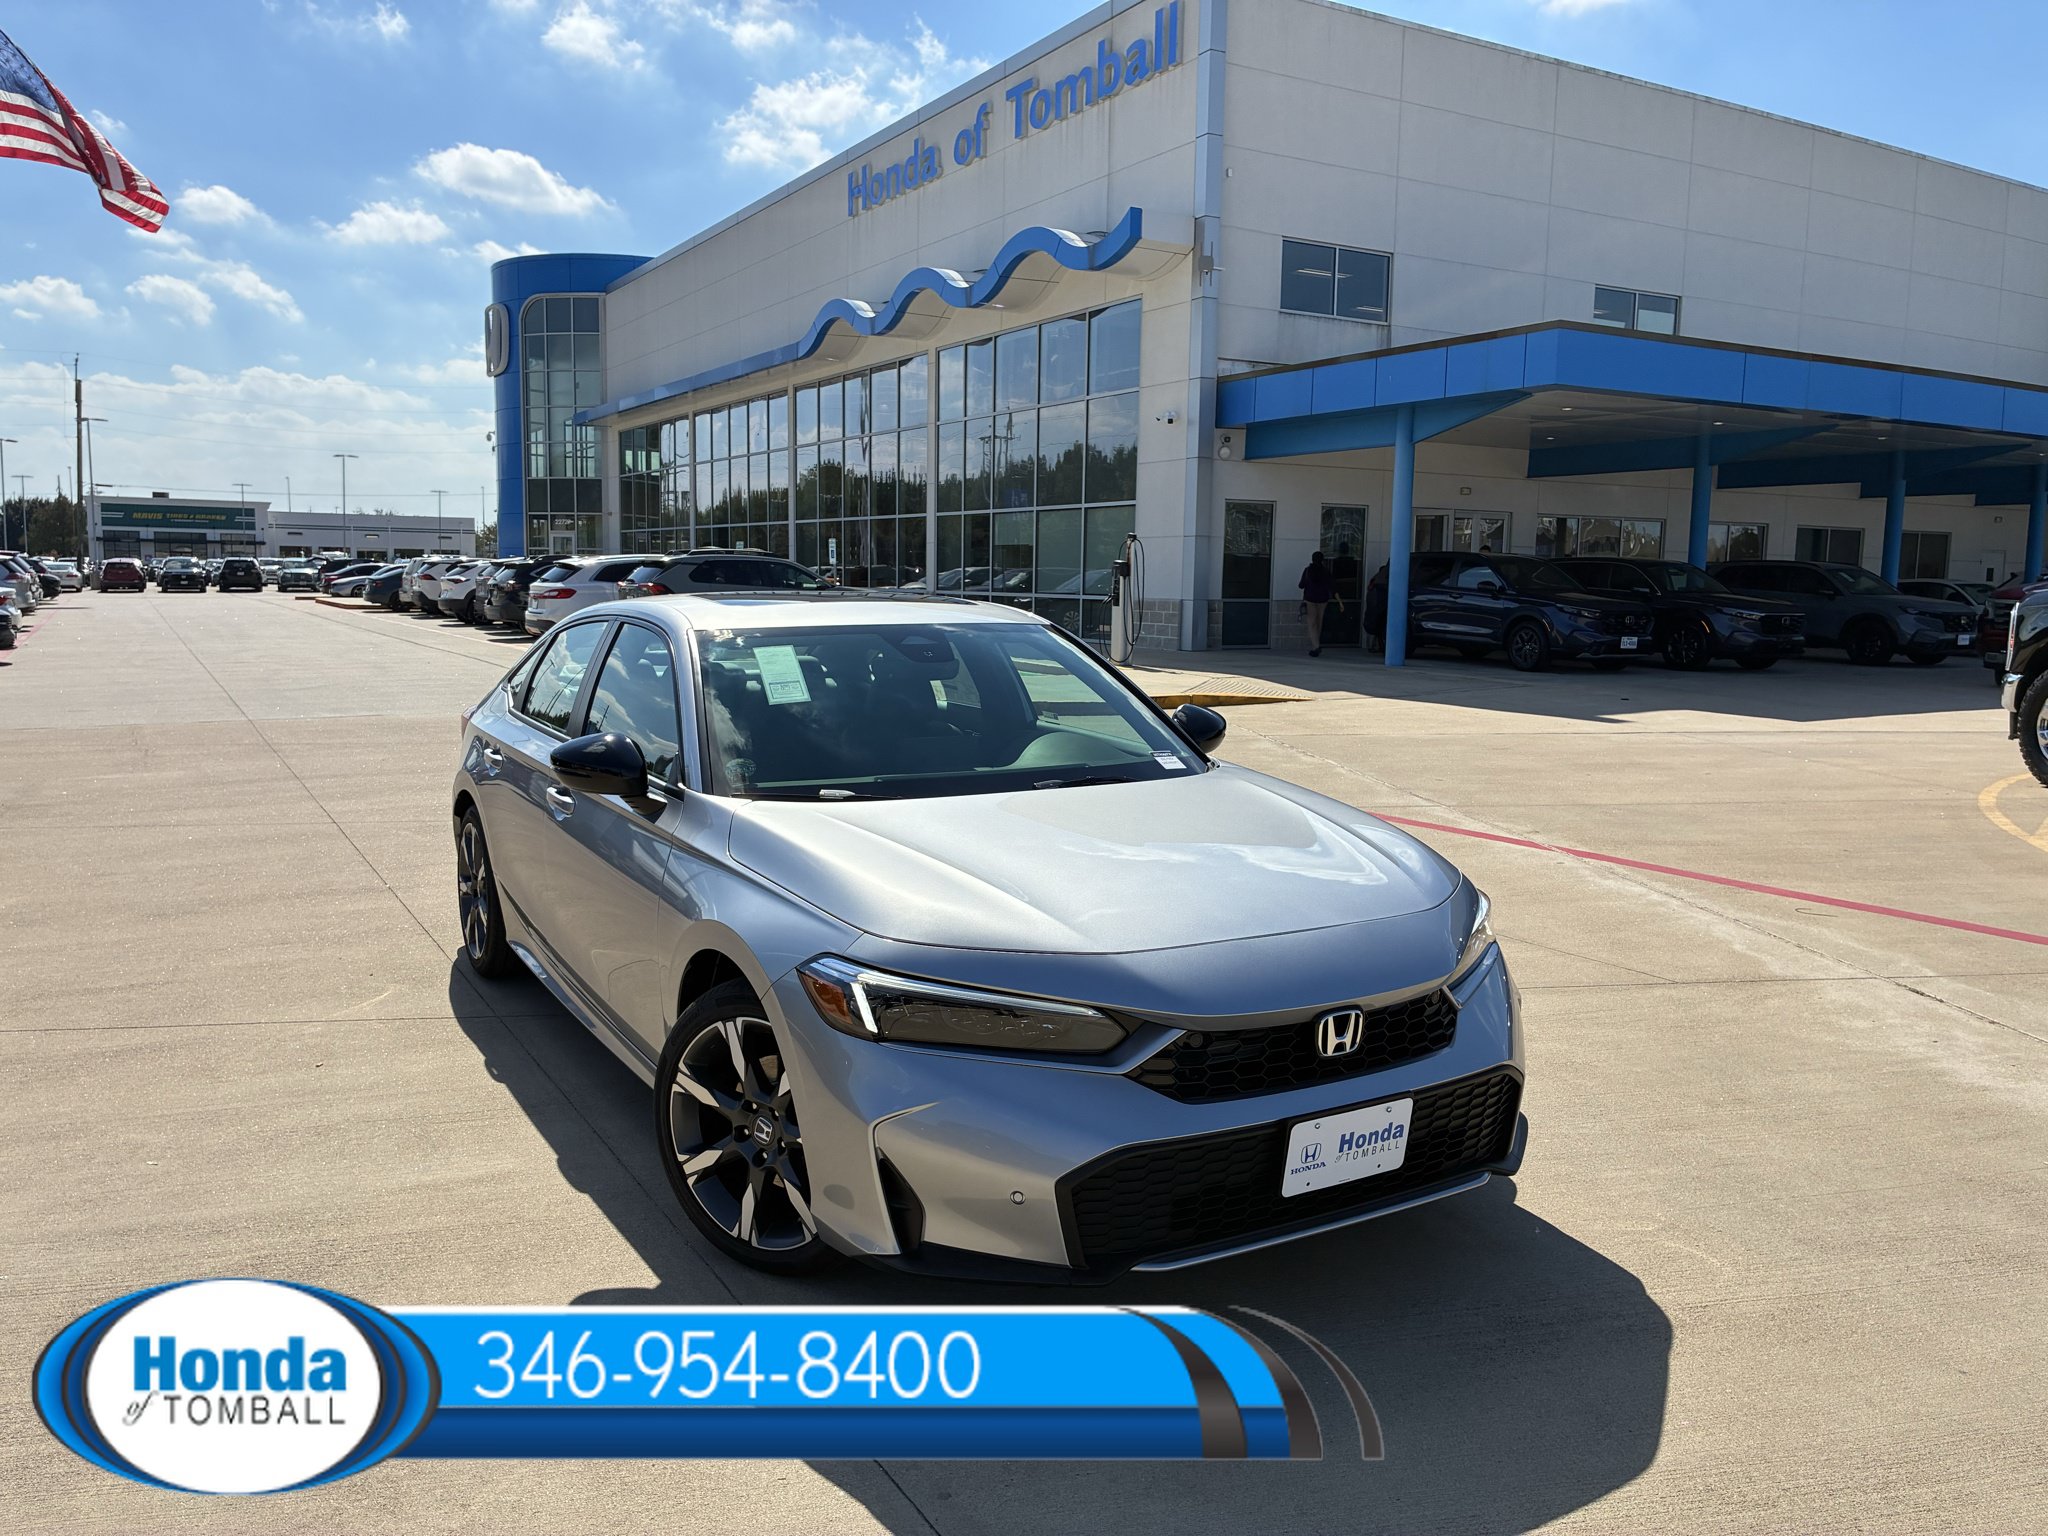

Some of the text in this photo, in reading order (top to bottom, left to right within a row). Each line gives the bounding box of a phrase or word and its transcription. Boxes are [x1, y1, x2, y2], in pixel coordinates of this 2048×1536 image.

[847, 1, 1182, 217] Honda of Tomball
[132, 512, 164, 520] MAVIS
[1338, 1122, 1405, 1153] Honda
[1345, 1140, 1400, 1162] TOMBALL
[1290, 1161, 1326, 1175] HONDA
